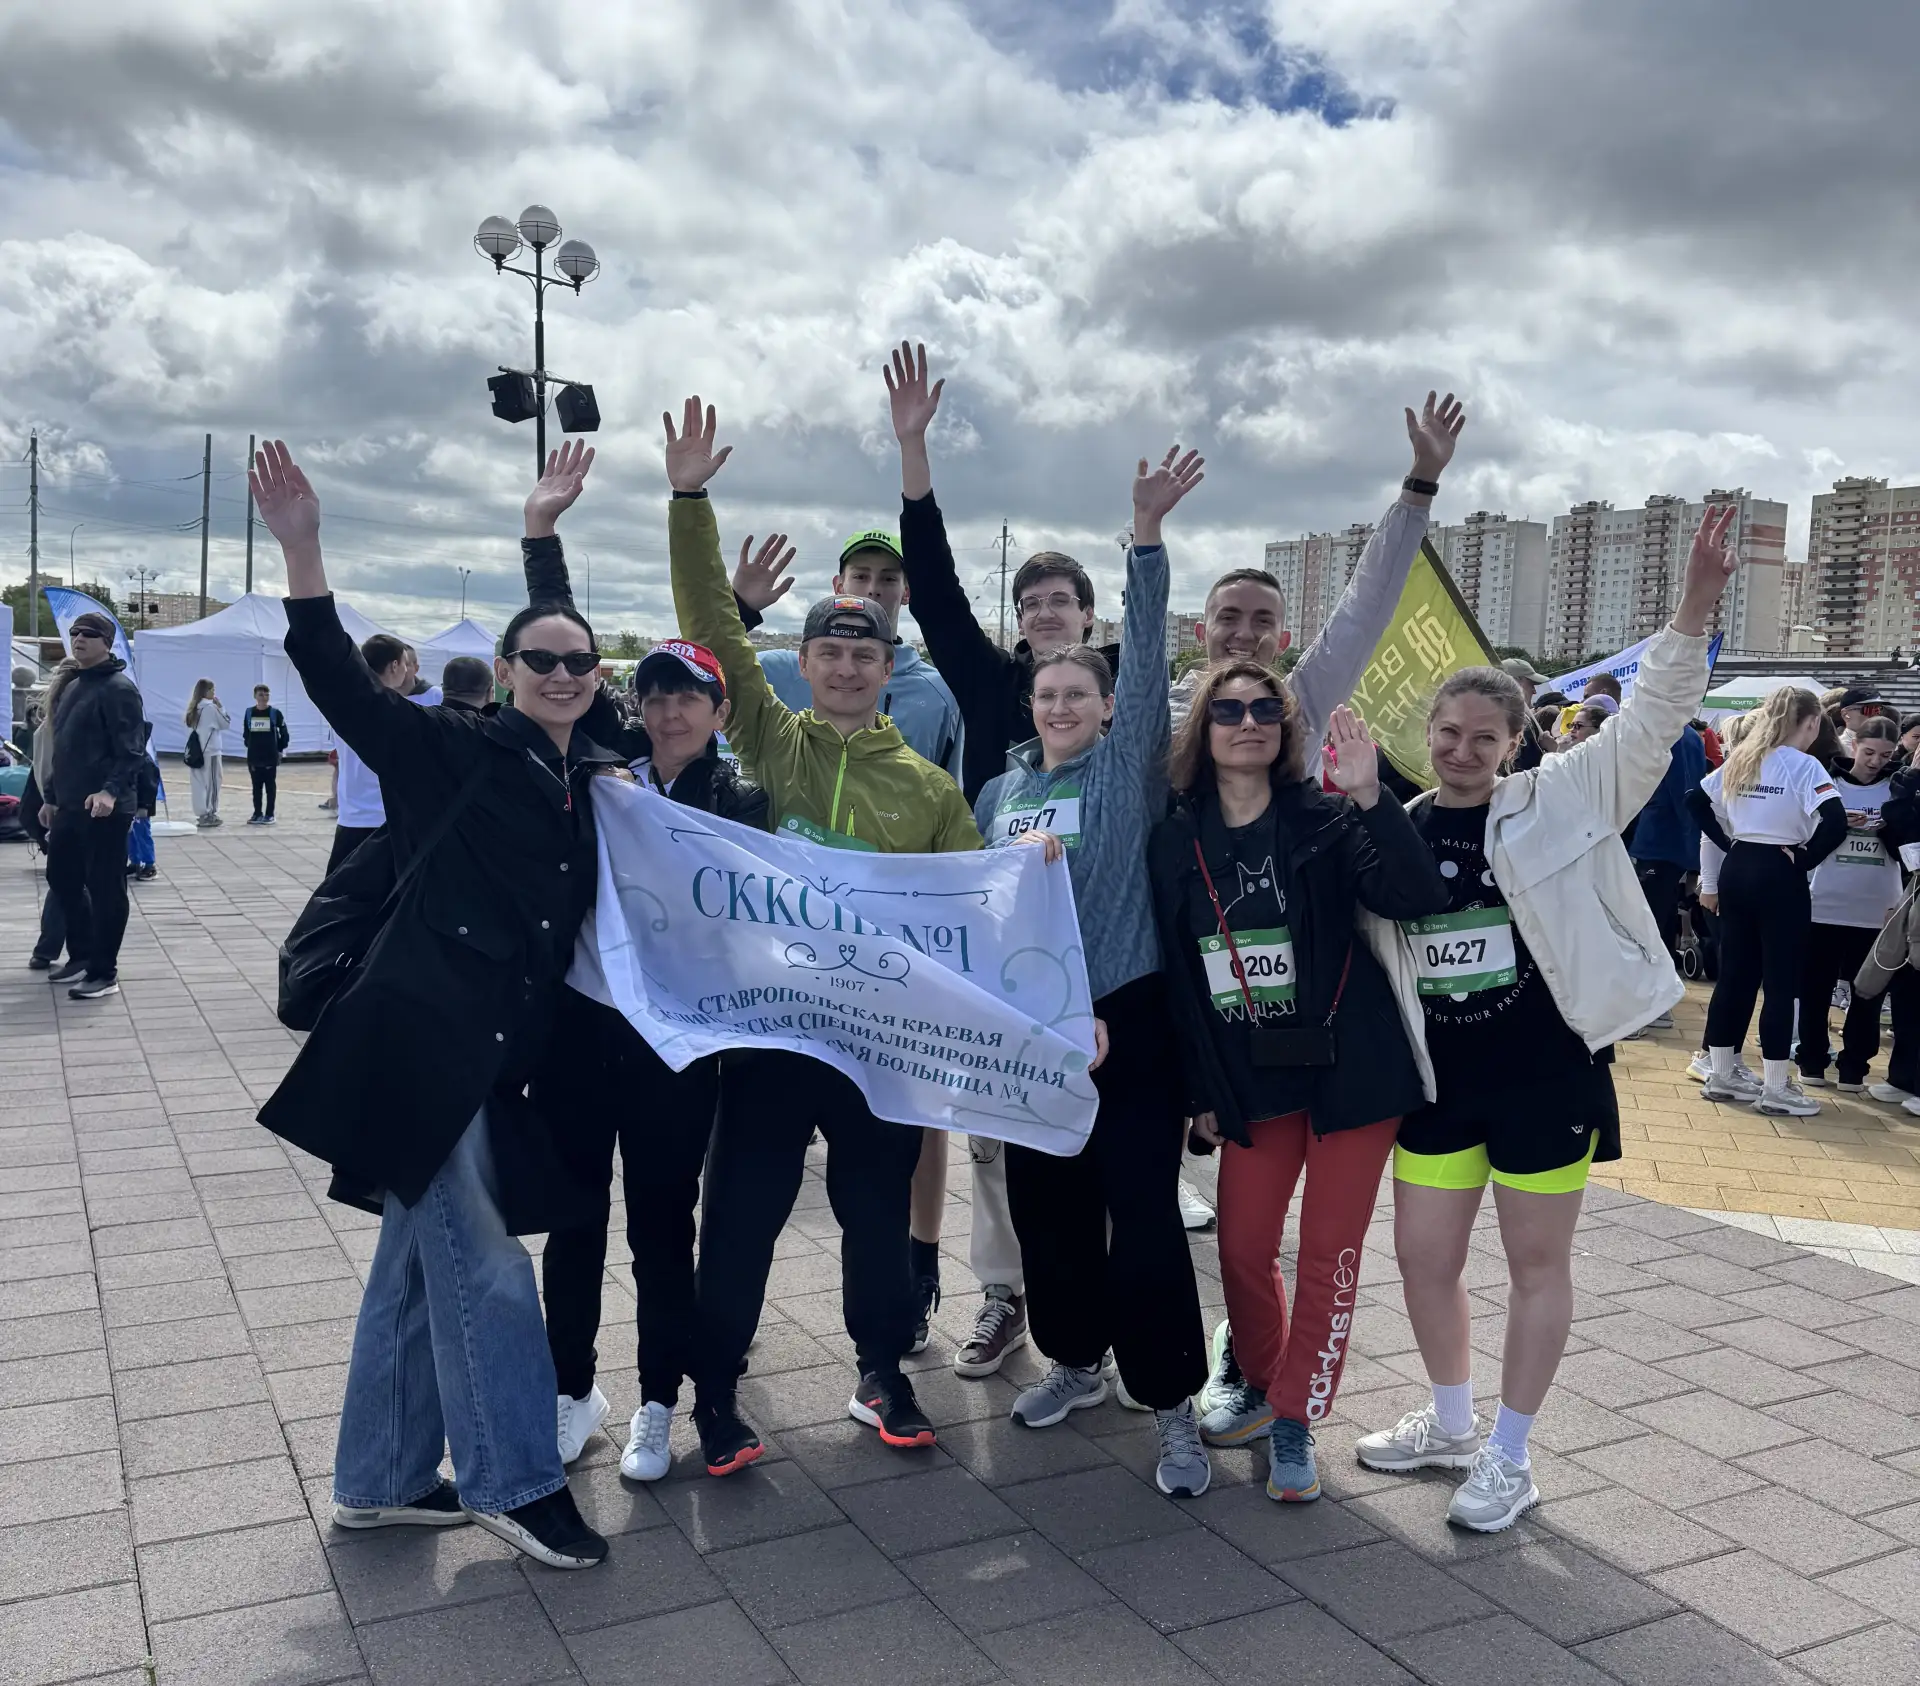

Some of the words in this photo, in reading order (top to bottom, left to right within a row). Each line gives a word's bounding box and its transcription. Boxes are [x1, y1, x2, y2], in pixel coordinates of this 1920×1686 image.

[829, 628, 858, 637] RUSSIA
[1008, 808, 1057, 836] 0517
[1441, 838, 1479, 851] MADE
[1849, 841, 1879, 853] 1047
[899, 924, 974, 973] №1
[1425, 938, 1487, 968] 0427
[1229, 954, 1289, 979] 0206
[829, 976, 866, 993] 1907
[698, 986, 896, 1027] СТАВРОПОЛЬСКАЯ
[902, 1017, 1004, 1048] КРАЕВАЯ
[1435, 1013, 1449, 1023] OF
[1456, 1010, 1493, 1025] YOUR
[798, 1012, 1066, 1089] СПЕЦИАЛИЗИРОВАННАЯ
[876, 1052, 994, 1096] БОЛЬНИЦА
[1000, 1083, 1029, 1104] №1
[1306, 1312, 1350, 1421] adidas
[1333, 1248, 1356, 1307] neo
